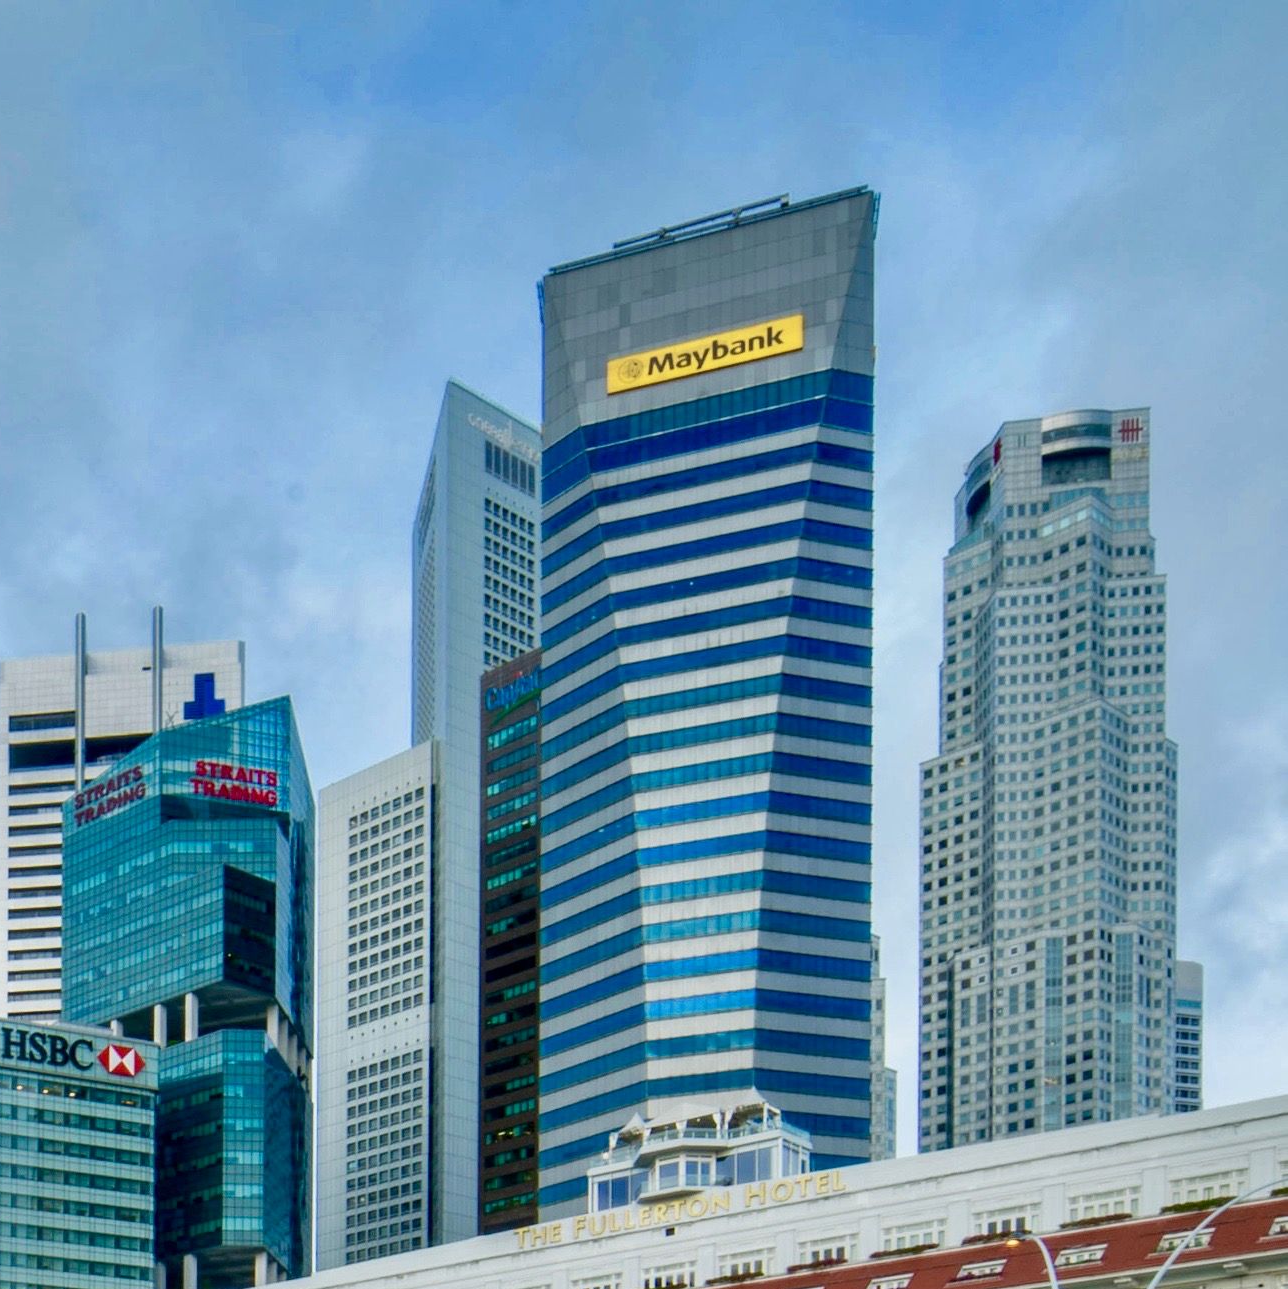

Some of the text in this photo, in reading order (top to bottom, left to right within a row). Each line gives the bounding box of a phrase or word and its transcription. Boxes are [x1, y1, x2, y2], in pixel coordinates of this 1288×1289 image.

[647, 326, 784, 375] Maybank
[75, 765, 143, 810] STRAITS
[189, 778, 278, 807] TRADING
[194, 760, 278, 786] STRAITS
[75, 782, 146, 827] TRADING
[0, 1027, 94, 1071] HSBC
[514, 1170, 847, 1249] THE FULLERTON HOTEL
